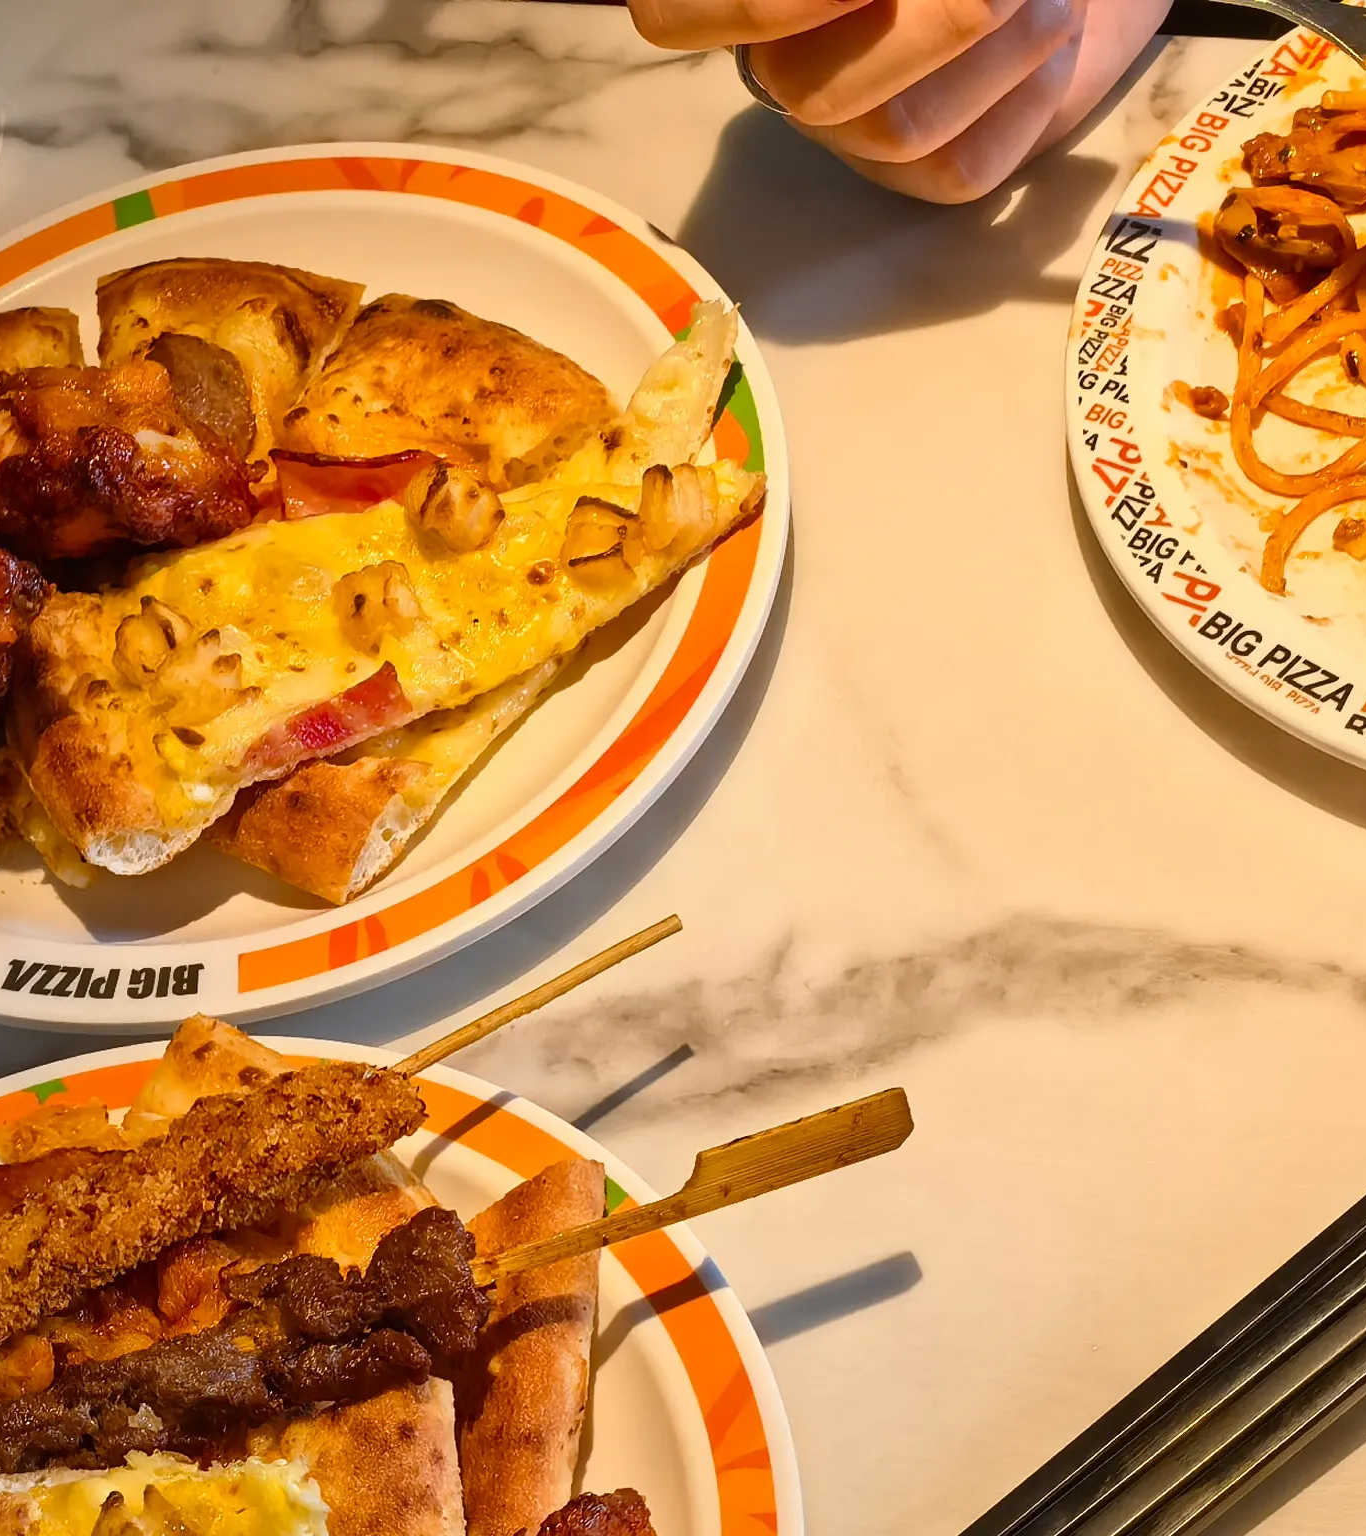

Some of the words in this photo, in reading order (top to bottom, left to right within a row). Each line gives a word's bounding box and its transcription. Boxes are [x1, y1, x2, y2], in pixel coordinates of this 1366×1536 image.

[1178, 111, 1230, 153] BIG
[1127, 154, 1199, 219] PIZZA
[1100, 303, 1128, 329] BIG
[1084, 403, 1128, 429] BIG
[1127, 527, 1180, 560] BIG
[1197, 610, 1264, 657] BIG
[1257, 643, 1355, 713] PIZZA
[1, 958, 121, 1000] PIZZA
[126, 962, 205, 1000] BIG
